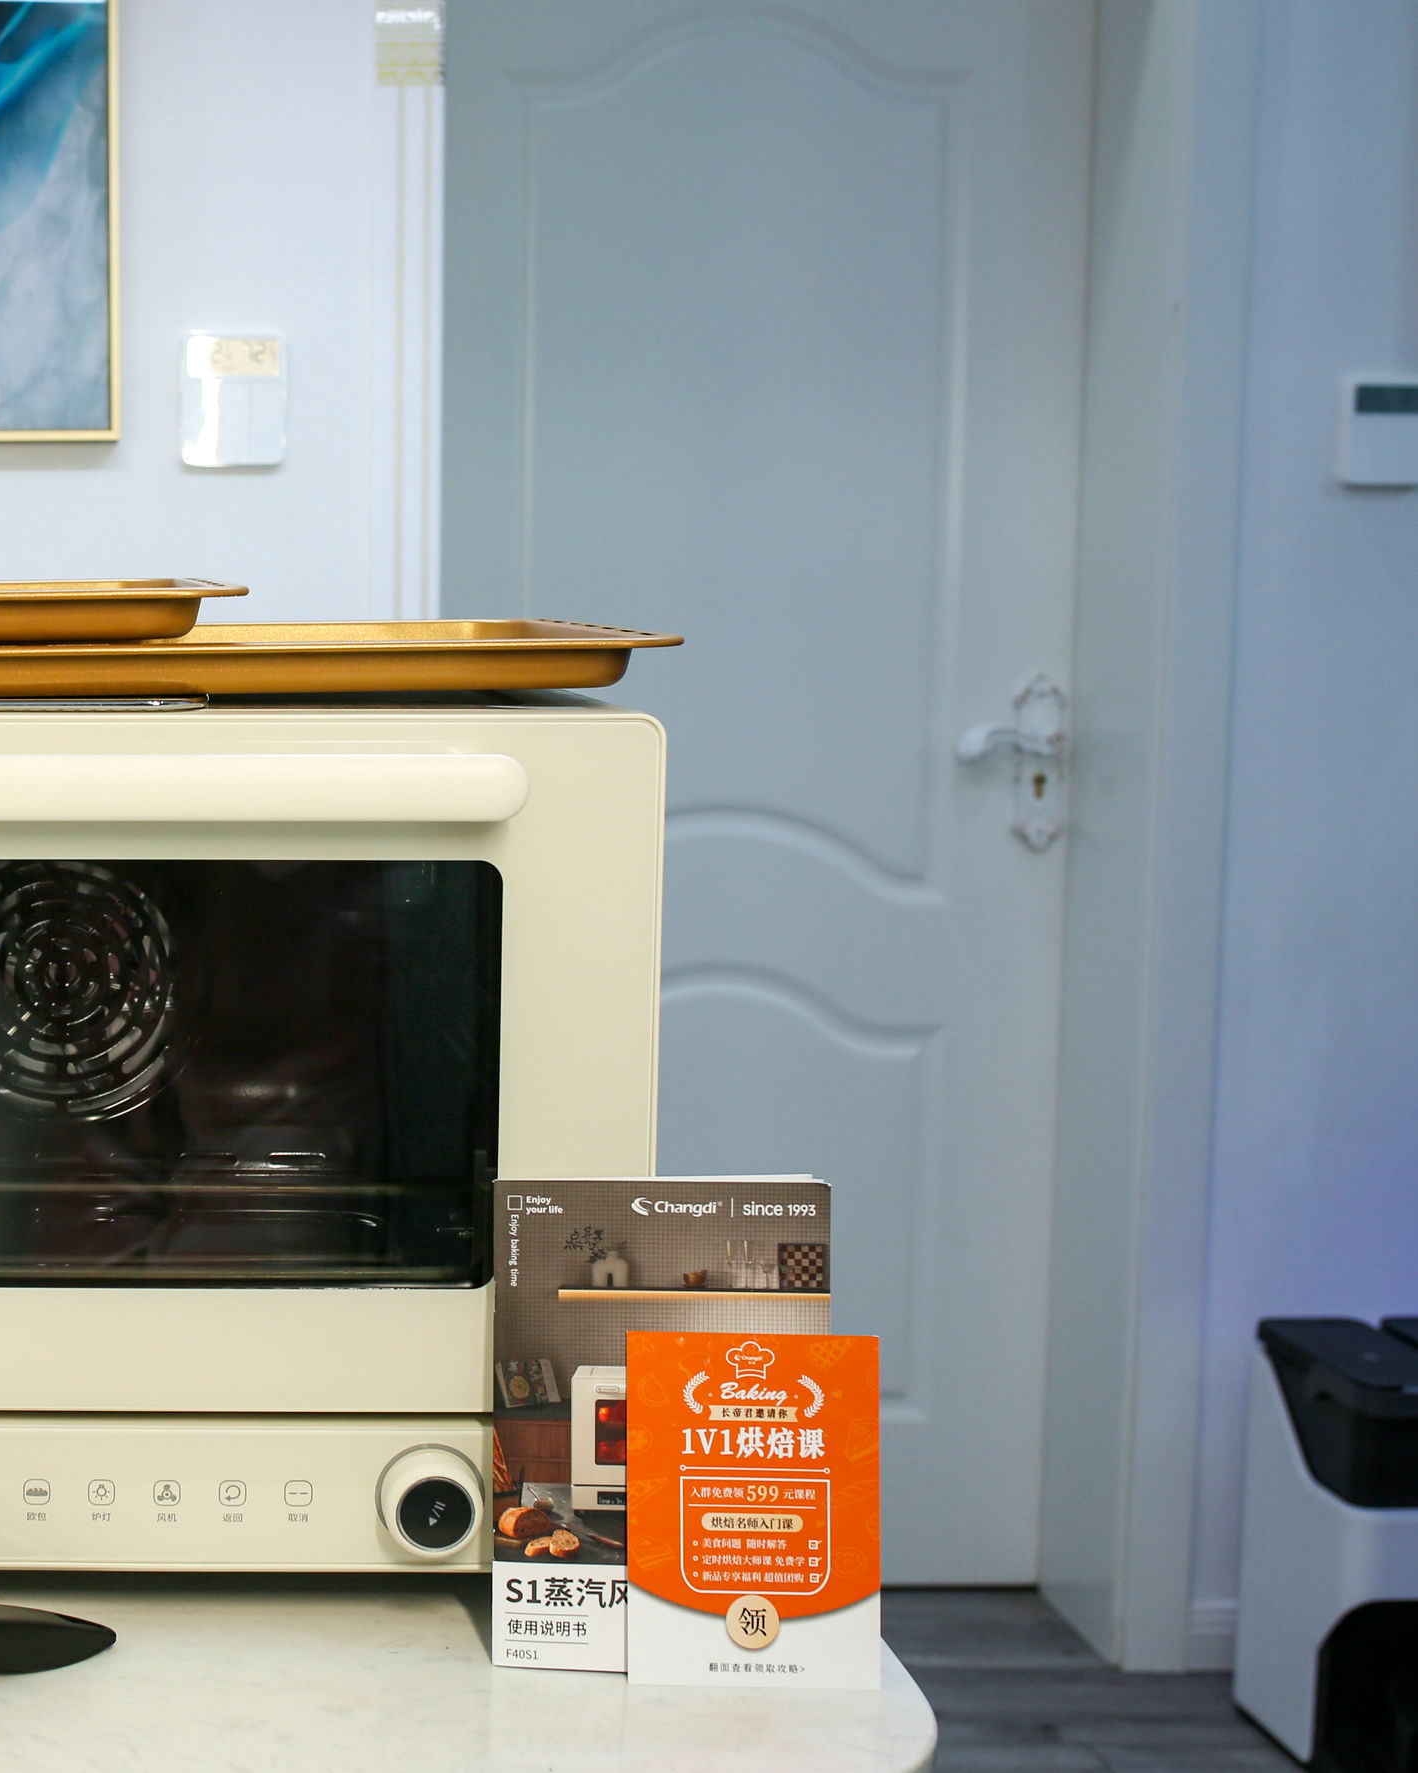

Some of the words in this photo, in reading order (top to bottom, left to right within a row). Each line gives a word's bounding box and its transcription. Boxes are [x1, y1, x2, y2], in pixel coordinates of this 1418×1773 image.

[525, 1195, 552, 1205] Enjoy
[525, 1206, 547, 1215] your
[548, 1205, 563, 1214] life
[742, 1201, 783, 1216] since
[787, 1204, 816, 1216] 1993
[508, 1214, 519, 1236] Enjoy
[508, 1239, 519, 1266] baking
[510, 1268, 519, 1287] time
[719, 1381, 788, 1407] Baking
[722, 1407, 788, 1419] 长帝君邀请你
[681, 1426, 826, 1460] 1V1烘焙课
[26, 1512, 47, 1521] 欧包
[91, 1512, 112, 1522] 炉灯
[156, 1513, 177, 1523] 风机
[222, 1513, 243, 1523] 返回
[288, 1513, 309, 1523] 取消
[711, 1516, 794, 1531] 烘焙名师入门课
[507, 1619, 587, 1637] 使用说明书
[738, 1607, 767, 1637] 领
[506, 1649, 538, 1660] F40S1
